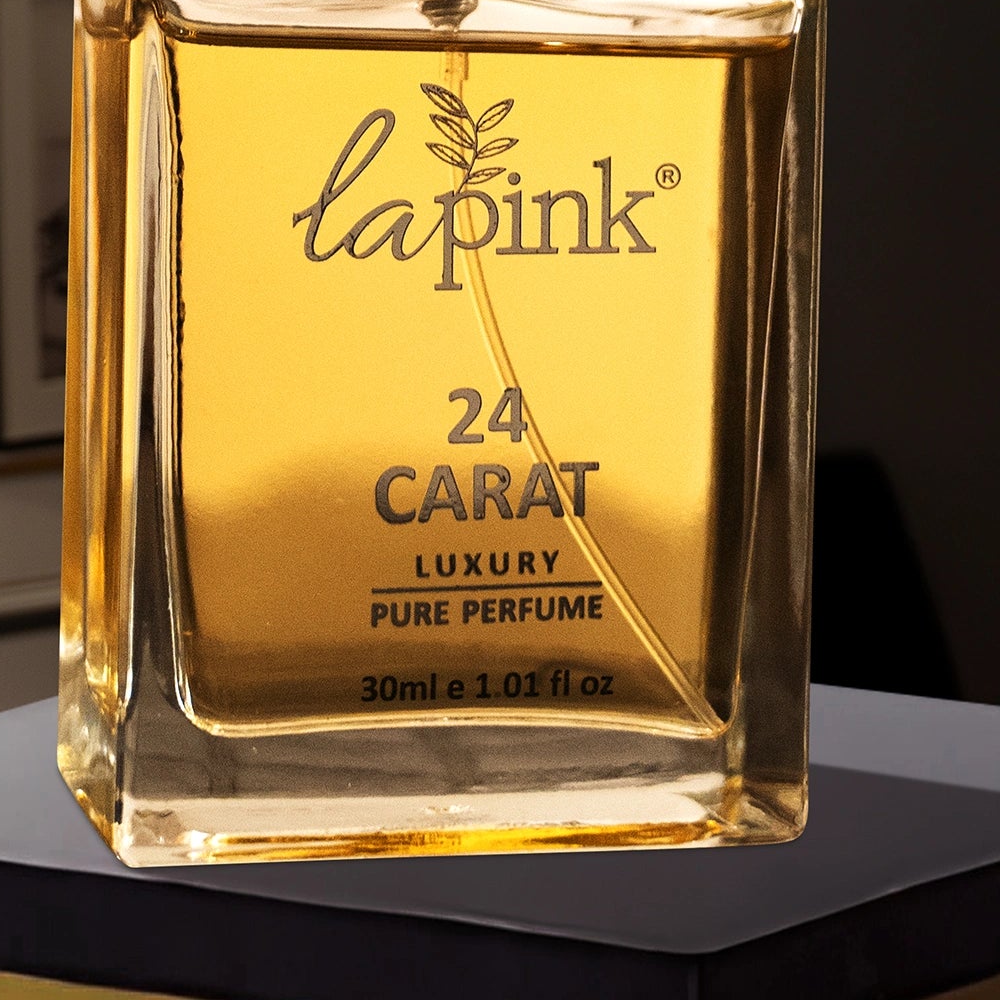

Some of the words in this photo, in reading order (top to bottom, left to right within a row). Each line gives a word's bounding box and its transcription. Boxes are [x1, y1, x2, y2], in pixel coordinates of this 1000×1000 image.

[447, 387, 528, 444] 24
[374, 461, 600, 525] CARAT
[415, 550, 560, 579] LUXURY
[370, 601, 450, 628] PURE
[462, 595, 604, 624] PERFUME
[360, 672, 438, 702] 30ml
[447, 677, 465, 699] e
[550, 669, 570, 697] fl
[580, 674, 615, 696] oz
